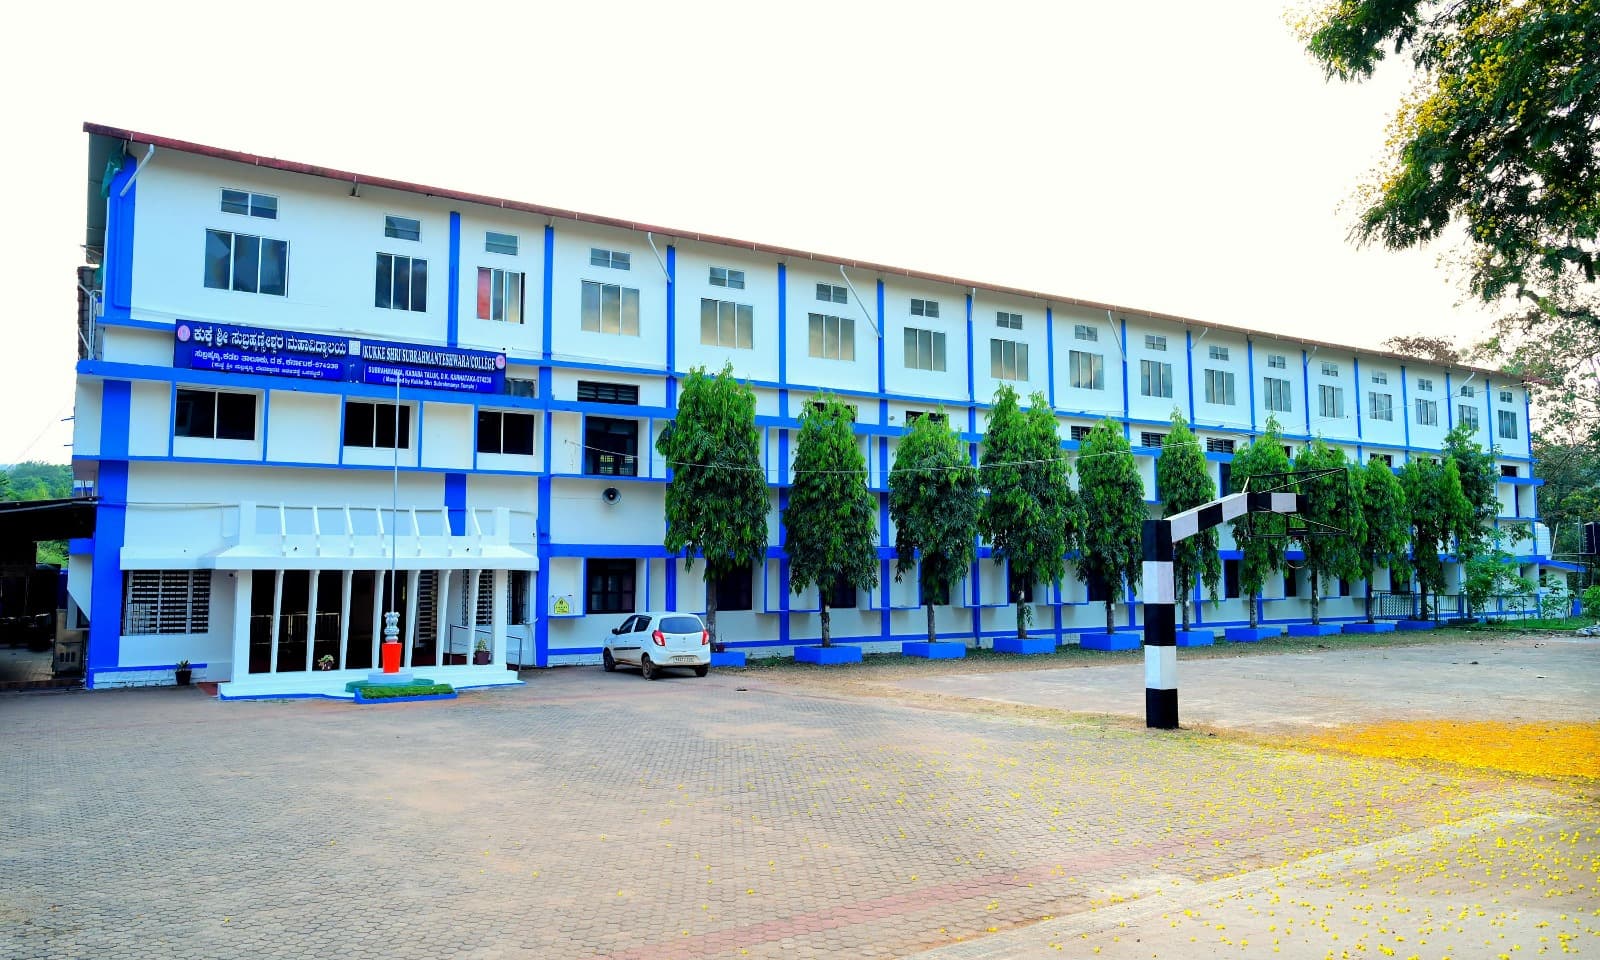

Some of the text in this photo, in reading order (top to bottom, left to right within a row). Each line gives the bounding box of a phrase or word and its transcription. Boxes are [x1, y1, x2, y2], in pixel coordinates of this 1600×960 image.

[216, 327, 228, 346] ಶ್ರೀ
[363, 345, 386, 360] KUKKE
[387, 347, 401, 361] SHRI
[470, 355, 496, 370] COLLEGE
